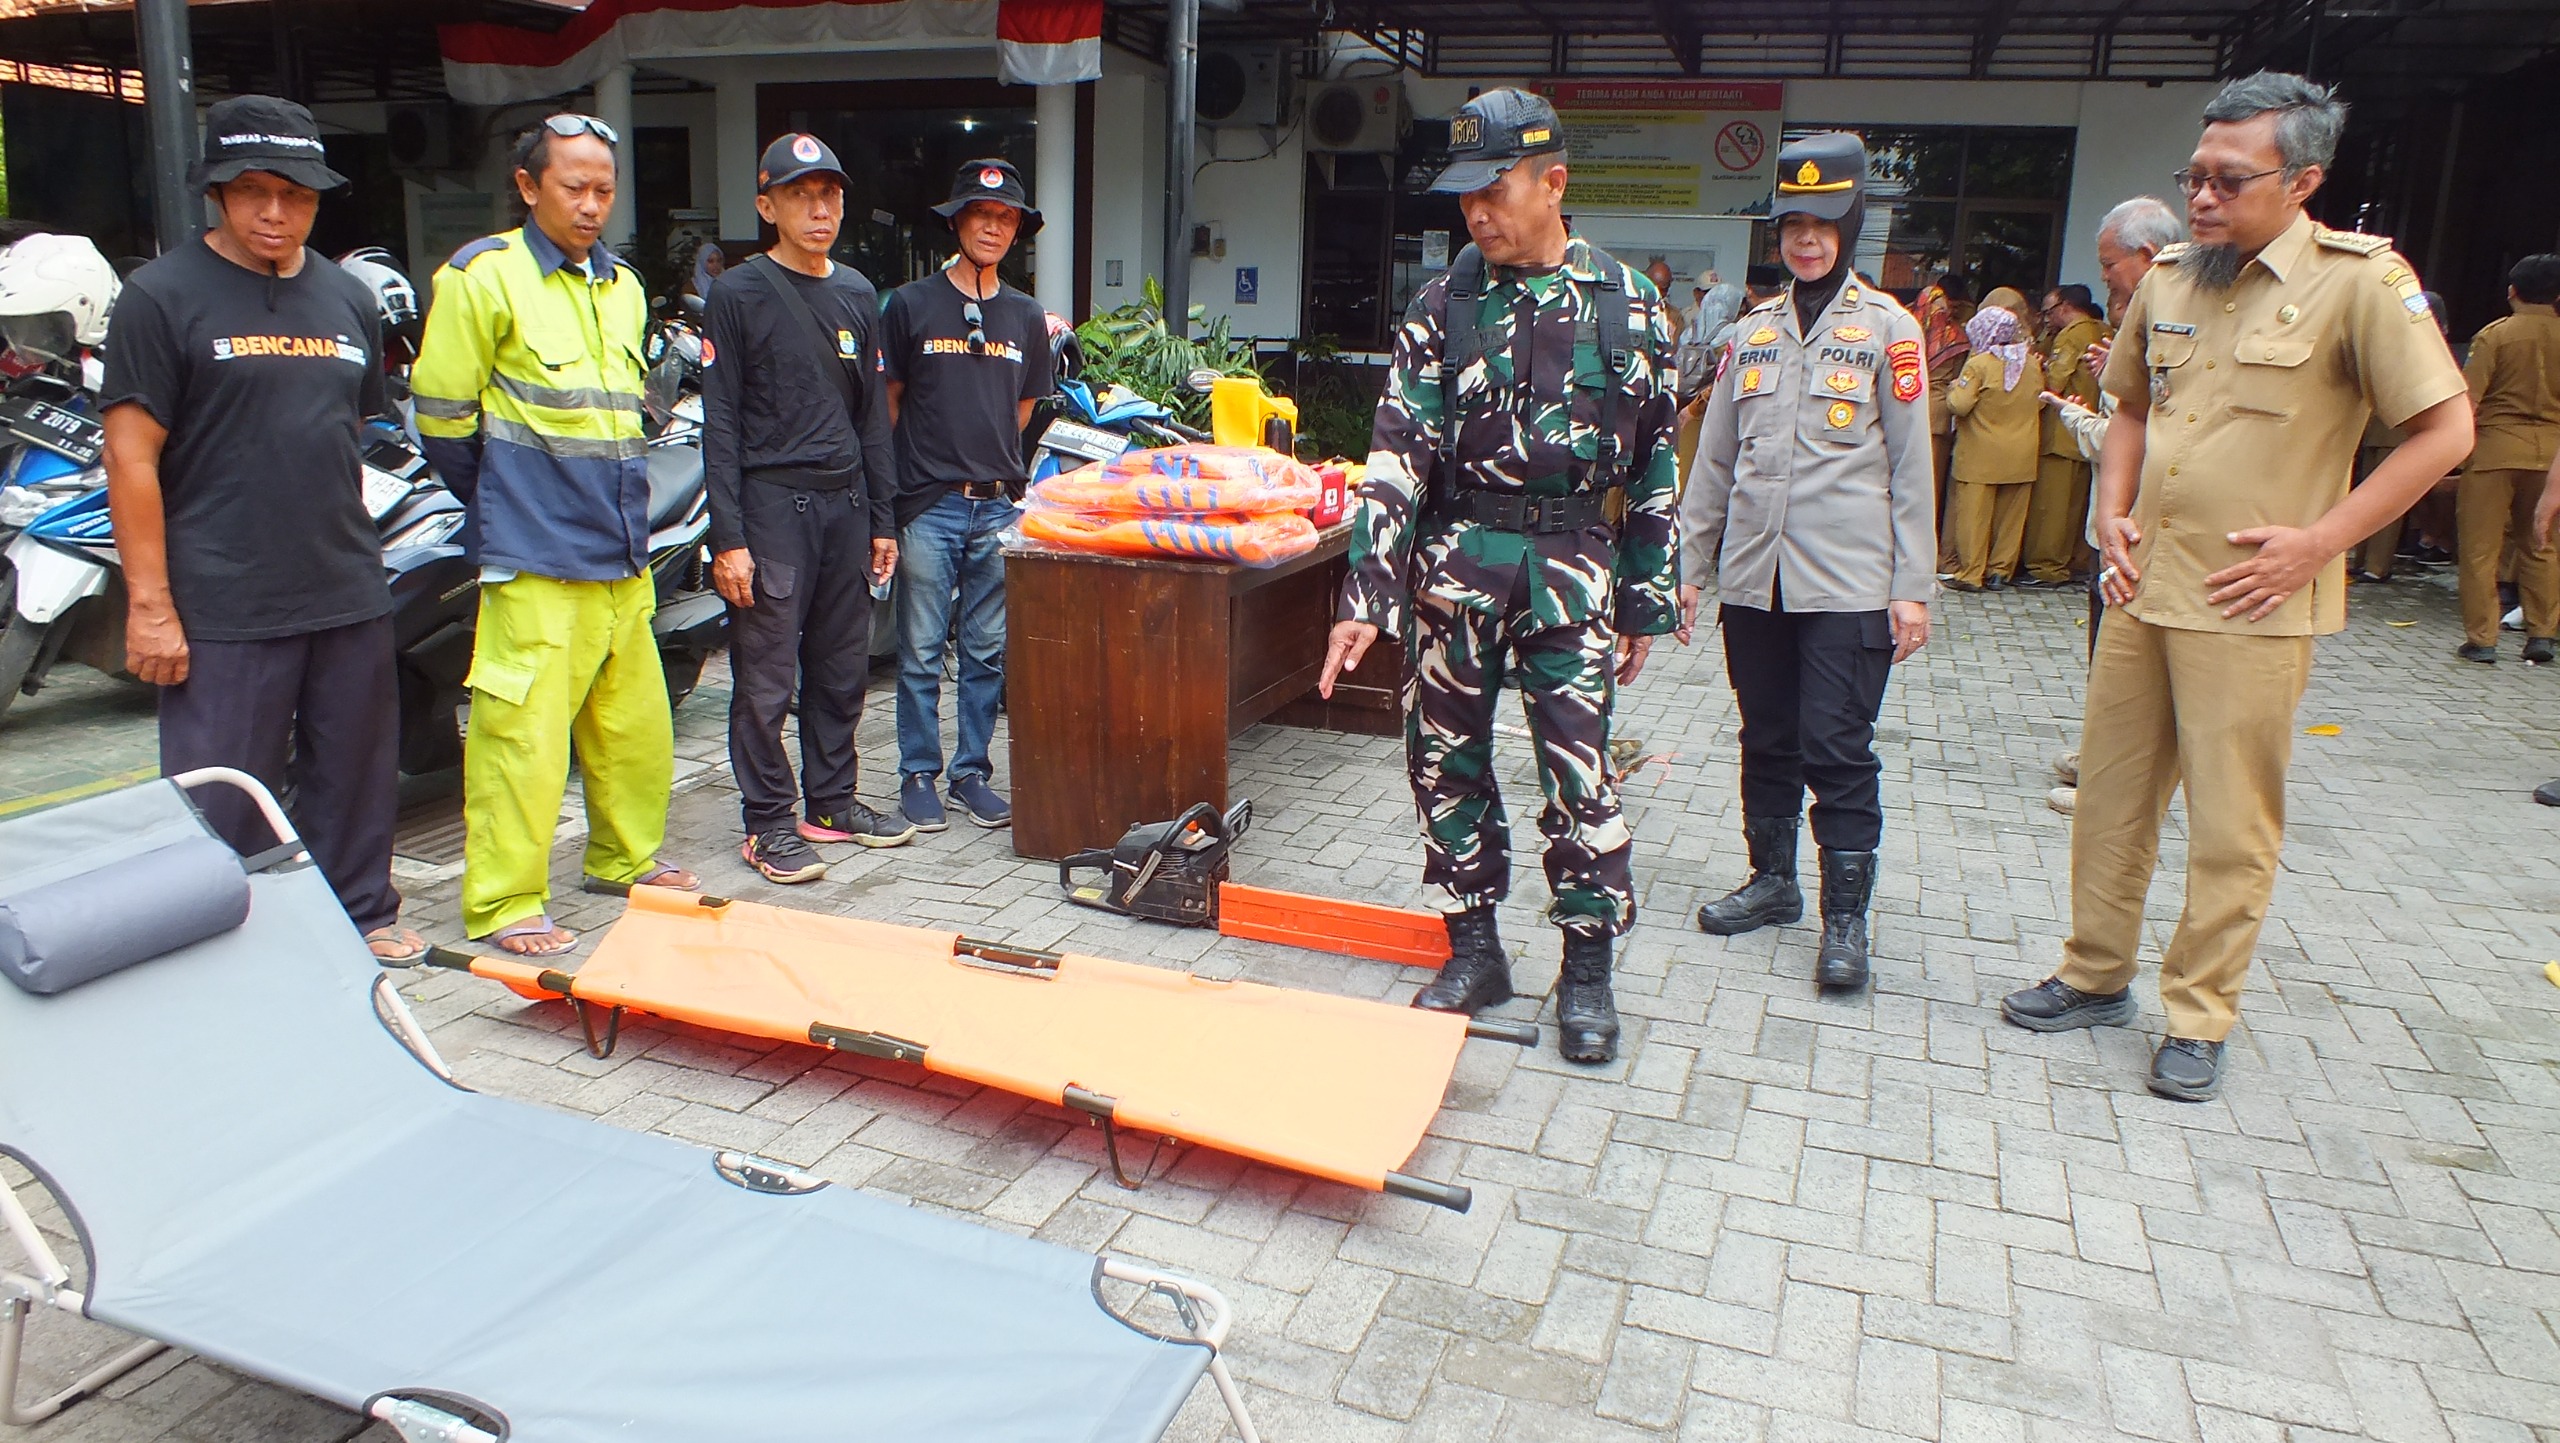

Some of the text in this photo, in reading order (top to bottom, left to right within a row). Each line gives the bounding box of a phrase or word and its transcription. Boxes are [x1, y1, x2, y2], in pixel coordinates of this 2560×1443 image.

[230, 335, 340, 357] BENCANA
[1738, 348, 1778, 366] ERNI
[1819, 347, 1874, 369] POLRI
[28, 405, 45, 420] E
[42, 411, 82, 434] 2079
